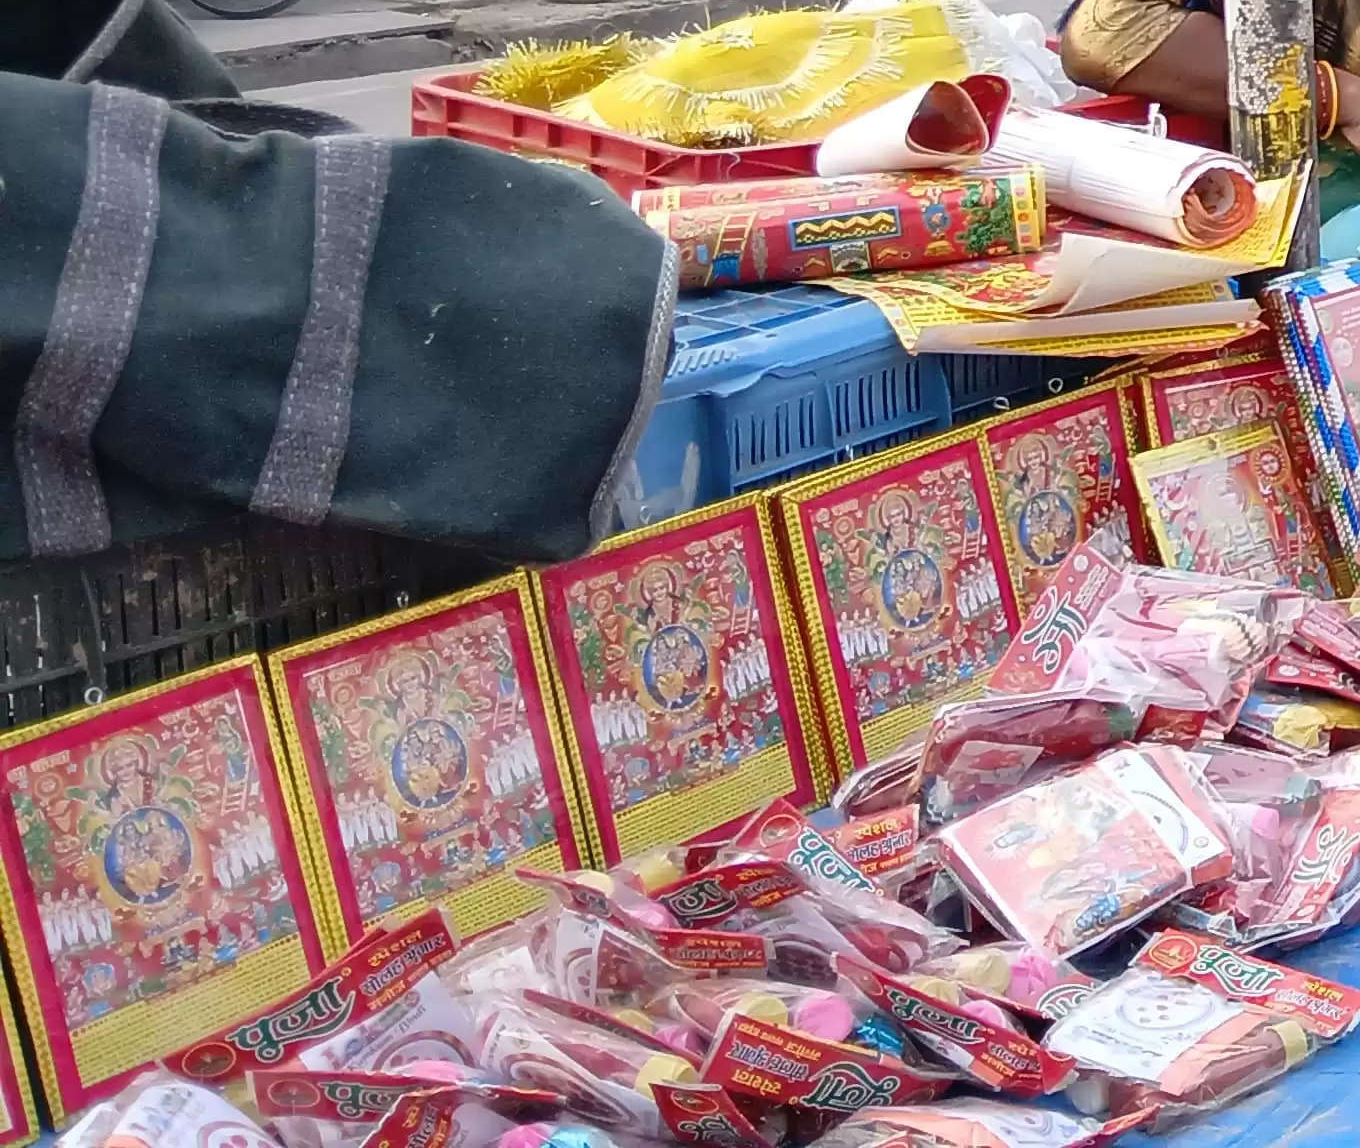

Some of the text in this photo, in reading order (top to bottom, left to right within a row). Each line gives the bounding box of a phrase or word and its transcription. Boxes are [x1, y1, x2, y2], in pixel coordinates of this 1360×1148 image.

[659, 875, 737, 925] जा
[368, 929, 422, 968] स्पेशल
[1189, 943, 1286, 998] पूजा
[225, 975, 356, 1064] पूजा
[731, 1067, 781, 1096] स्पेशल
[800, 1061, 901, 1112] पूजा
